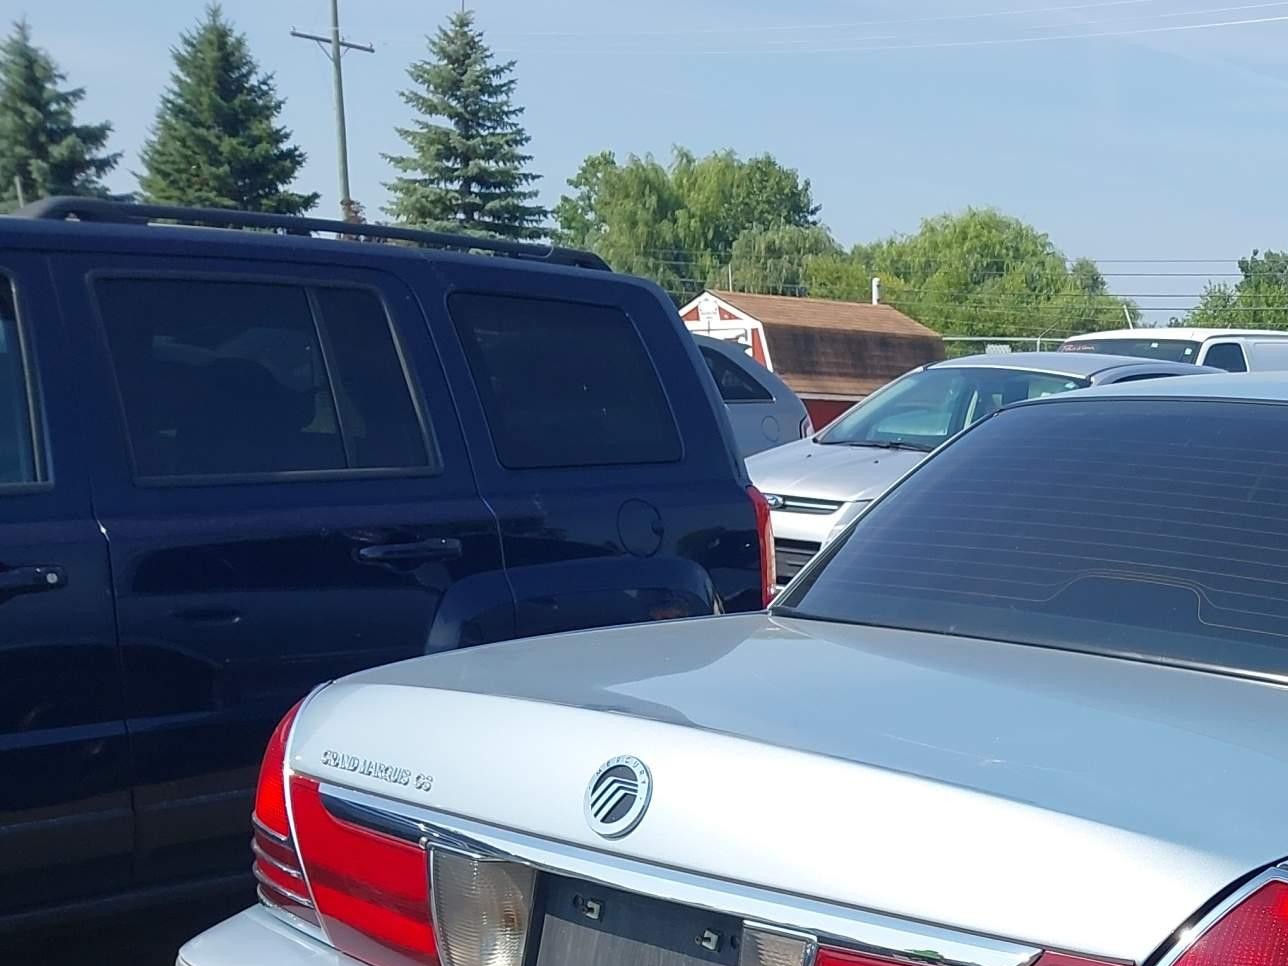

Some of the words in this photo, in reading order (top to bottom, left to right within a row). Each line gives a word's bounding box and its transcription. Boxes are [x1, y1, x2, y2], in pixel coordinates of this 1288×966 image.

[321, 749, 360, 773] GRAND
[360, 759, 411, 786] MARQUIS
[415, 773, 434, 792] GS
[595, 756, 646, 785] MERCURY
